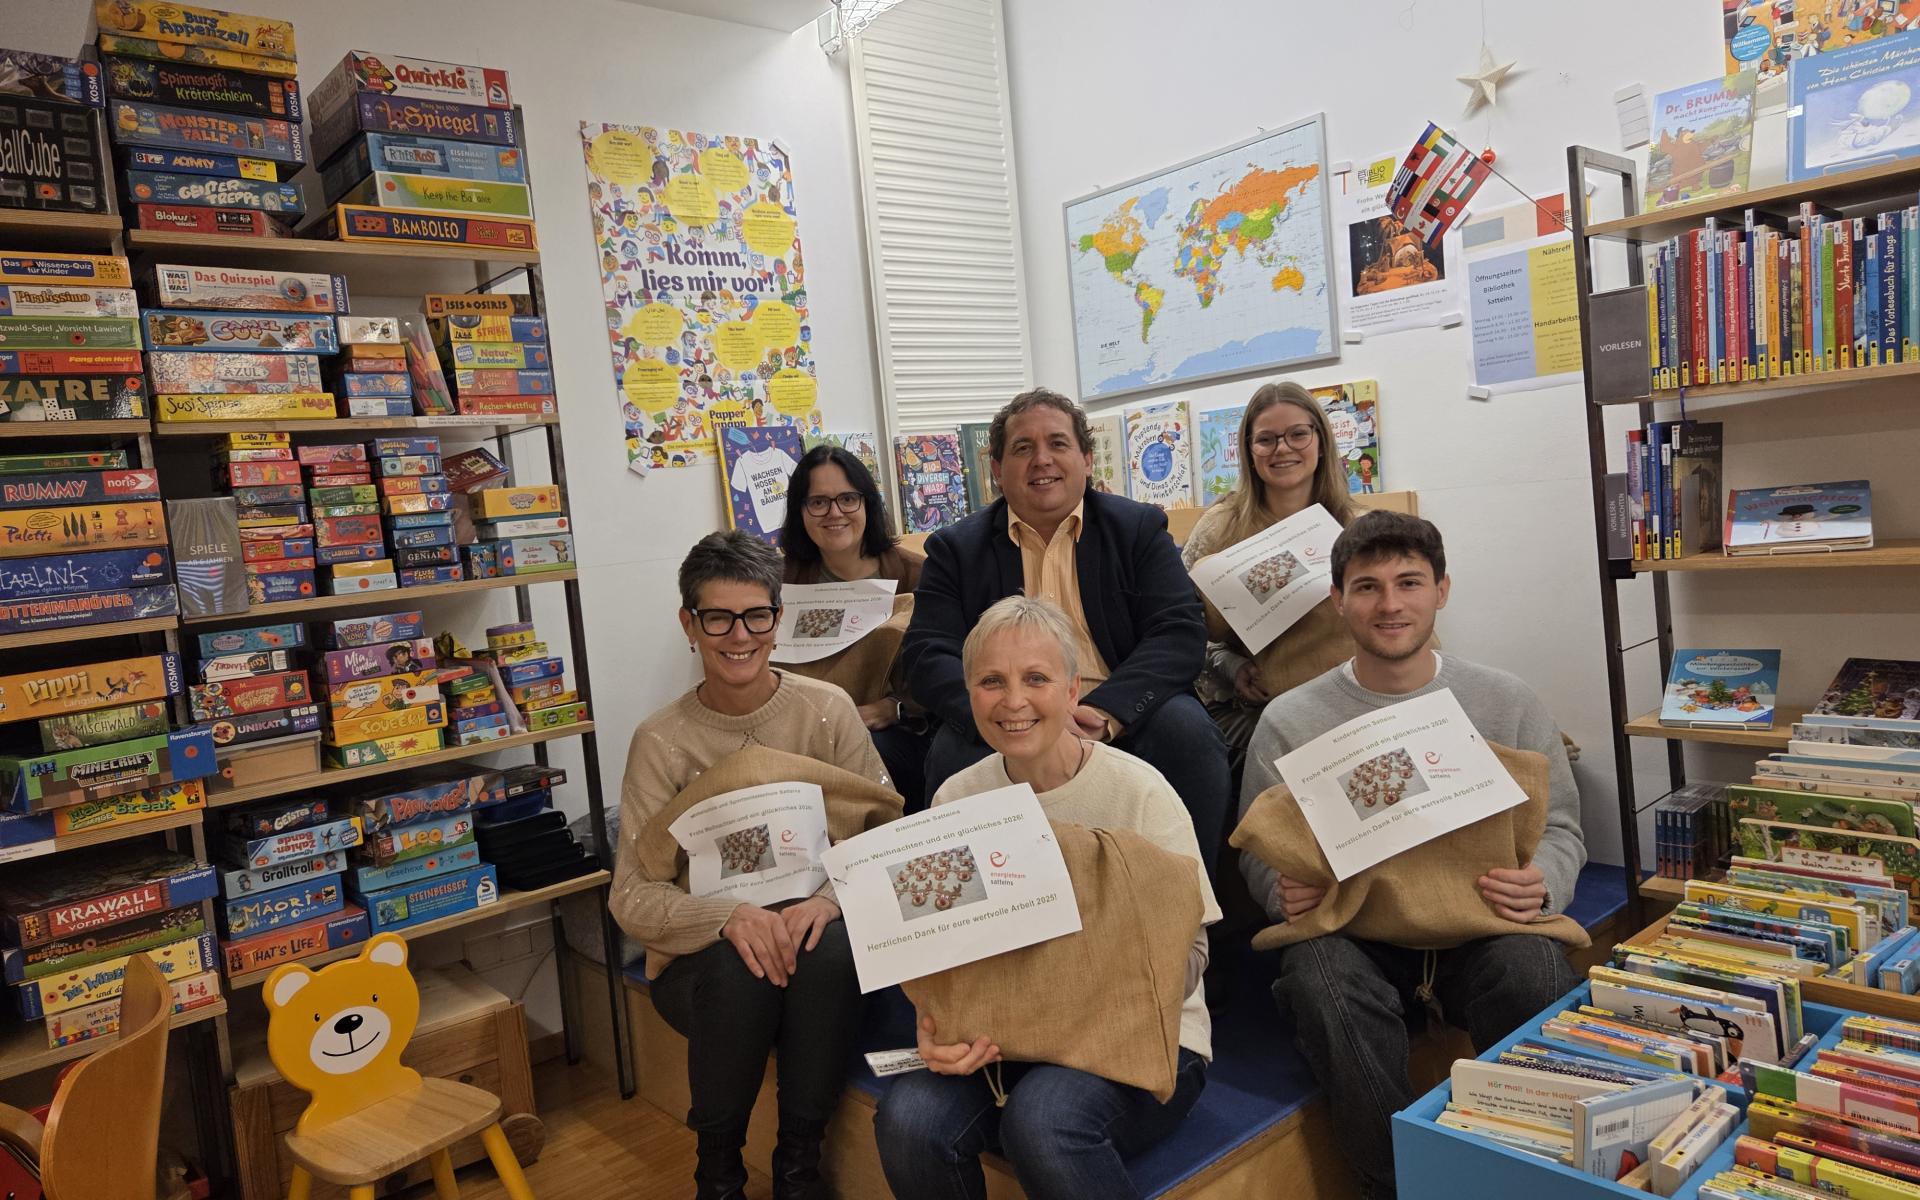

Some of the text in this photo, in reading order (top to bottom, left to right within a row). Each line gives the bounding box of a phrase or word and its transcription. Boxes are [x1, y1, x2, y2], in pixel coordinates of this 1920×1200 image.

[183, 11, 219, 28] Burg
[158, 18, 249, 46] Appenzell
[159, 71, 228, 86] Spinnengift
[395, 64, 468, 90] Qwirkle
[176, 87, 254, 103] Krötenschleim
[1665, 89, 1739, 115] Dr. BRUMM
[404, 105, 480, 136] Spiegel
[504, 111, 514, 143] KOSMOS
[182, 128, 229, 144] FALLE
[291, 124, 302, 161] KOSMOS
[173, 155, 215, 169] ACTIVITY
[423, 187, 443, 201] Keep
[392, 218, 459, 239] BAMBOLEO
[664, 242, 747, 269] Komm,
[1542, 244, 1572, 257] Nähtreff
[194, 271, 276, 286] Das Quizspiel
[641, 269, 774, 293] lies mir vor!
[1475, 267, 1522, 283] Öffnungszeiten
[334, 277, 345, 313] KOSMOS
[1483, 282, 1516, 294] Bibliothek
[1884, 235, 1897, 344] Das Vorlesebuch für Jungs
[445, 300, 464, 310] ISIS
[473, 300, 508, 310] OSIRIS
[1487, 295, 1513, 305] Satteins
[1599, 340, 1642, 353] VORLESEN
[69, 356, 91, 364] Fang
[224, 366, 262, 378] AZUL
[709, 409, 746, 424] Papper
[259, 433, 268, 441] 77
[107, 475, 137, 488] noris
[751, 467, 783, 482] WACHSEN
[3, 480, 87, 502] RUMMY
[754, 477, 777, 490] HOSEN
[763, 487, 772, 495] AN
[1151, 480, 1169, 491] Dinos
[189, 543, 229, 556] SPIELE
[344, 651, 366, 668] Mia
[351, 659, 378, 675] London
[166, 656, 178, 693] KOSMOS
[21, 671, 90, 705] Pippi
[75, 717, 136, 735] MISCHWALD
[1332, 714, 1397, 744] Kindergarten Satteins
[169, 730, 212, 741] Ravensburger
[1301, 770, 1321, 785] Frohe
[1321, 748, 1365, 773] Weihnachten
[1365, 740, 1380, 750] und
[1392, 724, 1430, 742] glückliches
[73, 751, 153, 777] MINECRAFT
[116, 800, 175, 815] Break
[895, 809, 961, 832] Bibliothek Satteins
[1335, 827, 1372, 851] Herzlichen
[1372, 819, 1392, 834] Dank
[1391, 813, 1403, 823] für
[1403, 807, 1420, 819] eure
[1420, 794, 1453, 812] wertvolle
[1453, 785, 1475, 800] Arbeit
[400, 828, 443, 850] Leo
[845, 856, 870, 872] Frohe
[870, 841, 924, 861] Weihnachten
[925, 835, 942, 845] und
[943, 831, 956, 841] ein
[957, 820, 1003, 838] glückliches
[170, 869, 213, 885] Ravensburger
[990, 871, 1026, 879] energieteam
[409, 880, 468, 904] STEINBEISSER
[55, 888, 157, 925] KRAWALL
[68, 904, 145, 932] vorm Stall
[328, 915, 365, 928] Ravensburger
[866, 893, 1058, 953] Herzlichen Dank für eure wertvolle Arbeit 2025!
[203, 937, 214, 967] KOSMOS
[1535, 1088, 1550, 1097] der
